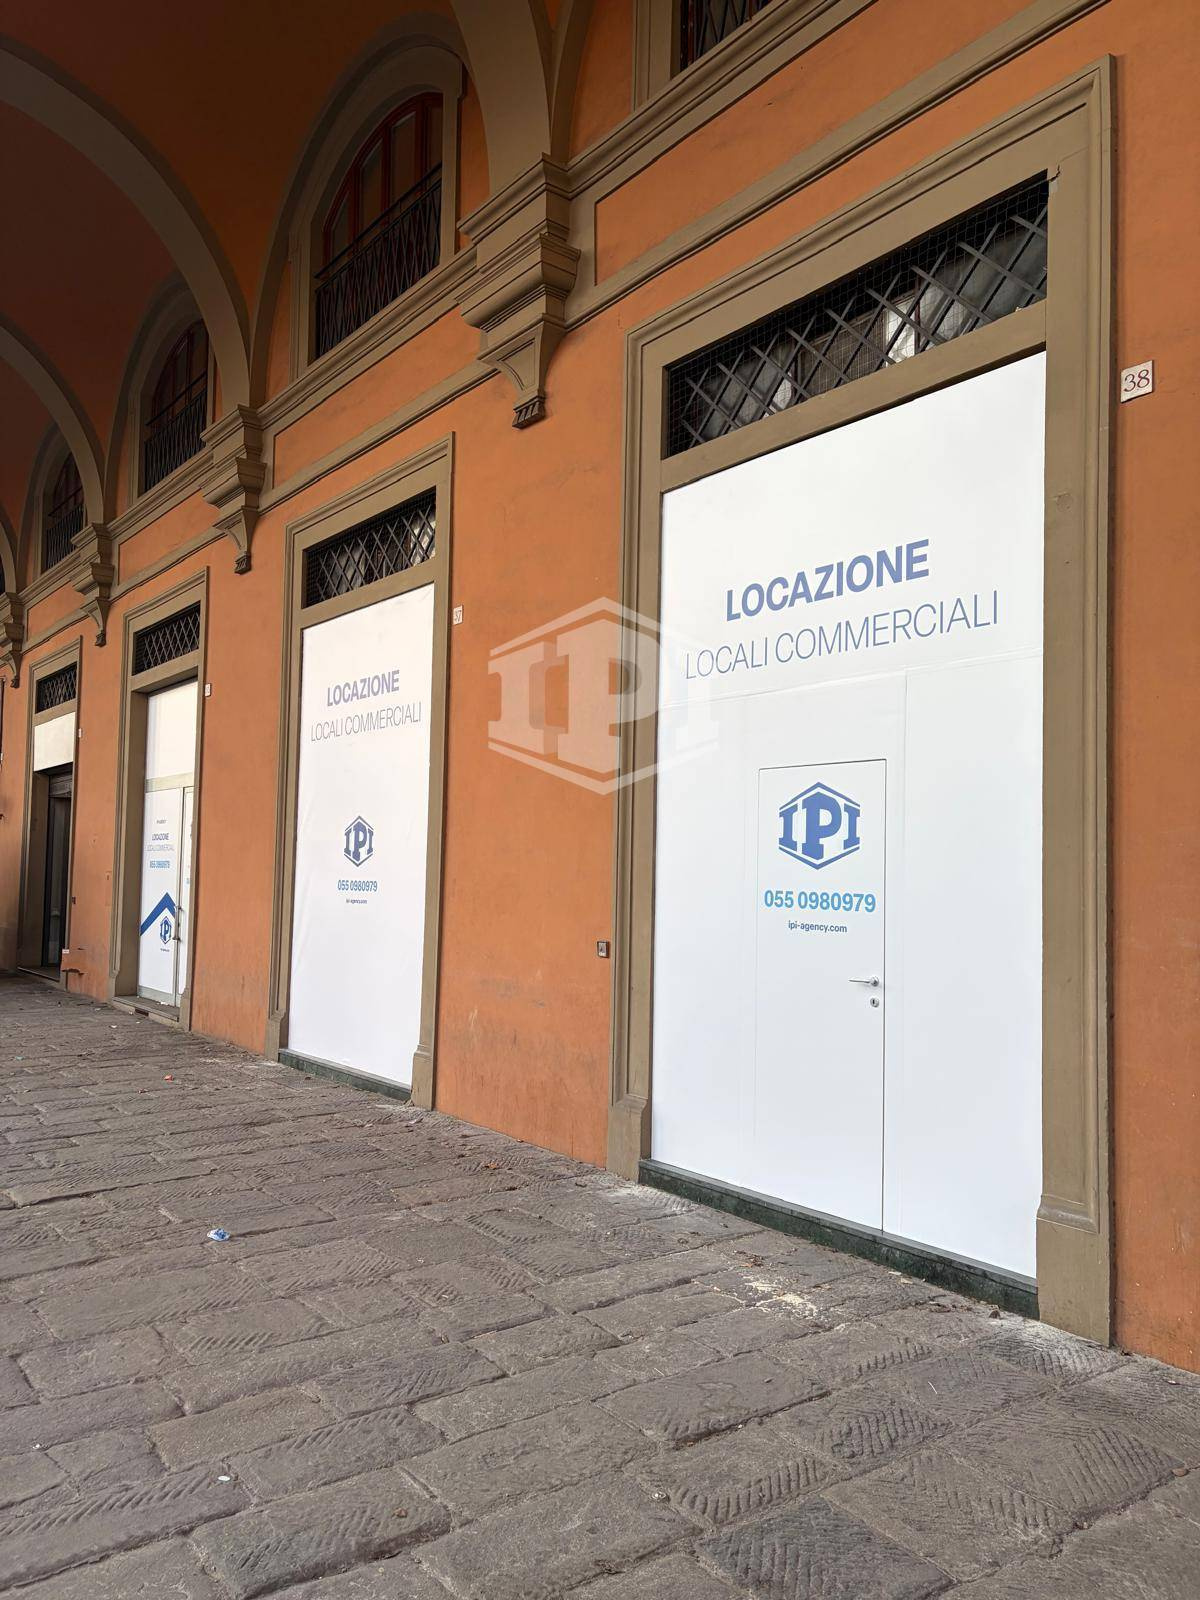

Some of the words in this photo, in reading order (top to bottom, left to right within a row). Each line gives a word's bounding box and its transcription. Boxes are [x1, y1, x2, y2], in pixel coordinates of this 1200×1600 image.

[1123, 368, 1151, 393] 38
[726, 538, 930, 622] LOCAZIONE
[685, 637, 768, 680] LOCALI
[775, 590, 998, 664] COMMERCIALI
[327, 669, 400, 707] LOCAZIONE
[311, 718, 344, 742] LOCALI
[345, 702, 422, 736] COMMERCIALI
[343, 820, 374, 862] IPI
[778, 790, 861, 861] IPI
[337, 879, 350, 891] 055
[350, 880, 378, 892] 0980979
[764, 889, 794, 909] 055
[797, 890, 877, 914] 0980979
[787, 919, 848, 933] ipi-agency.com
